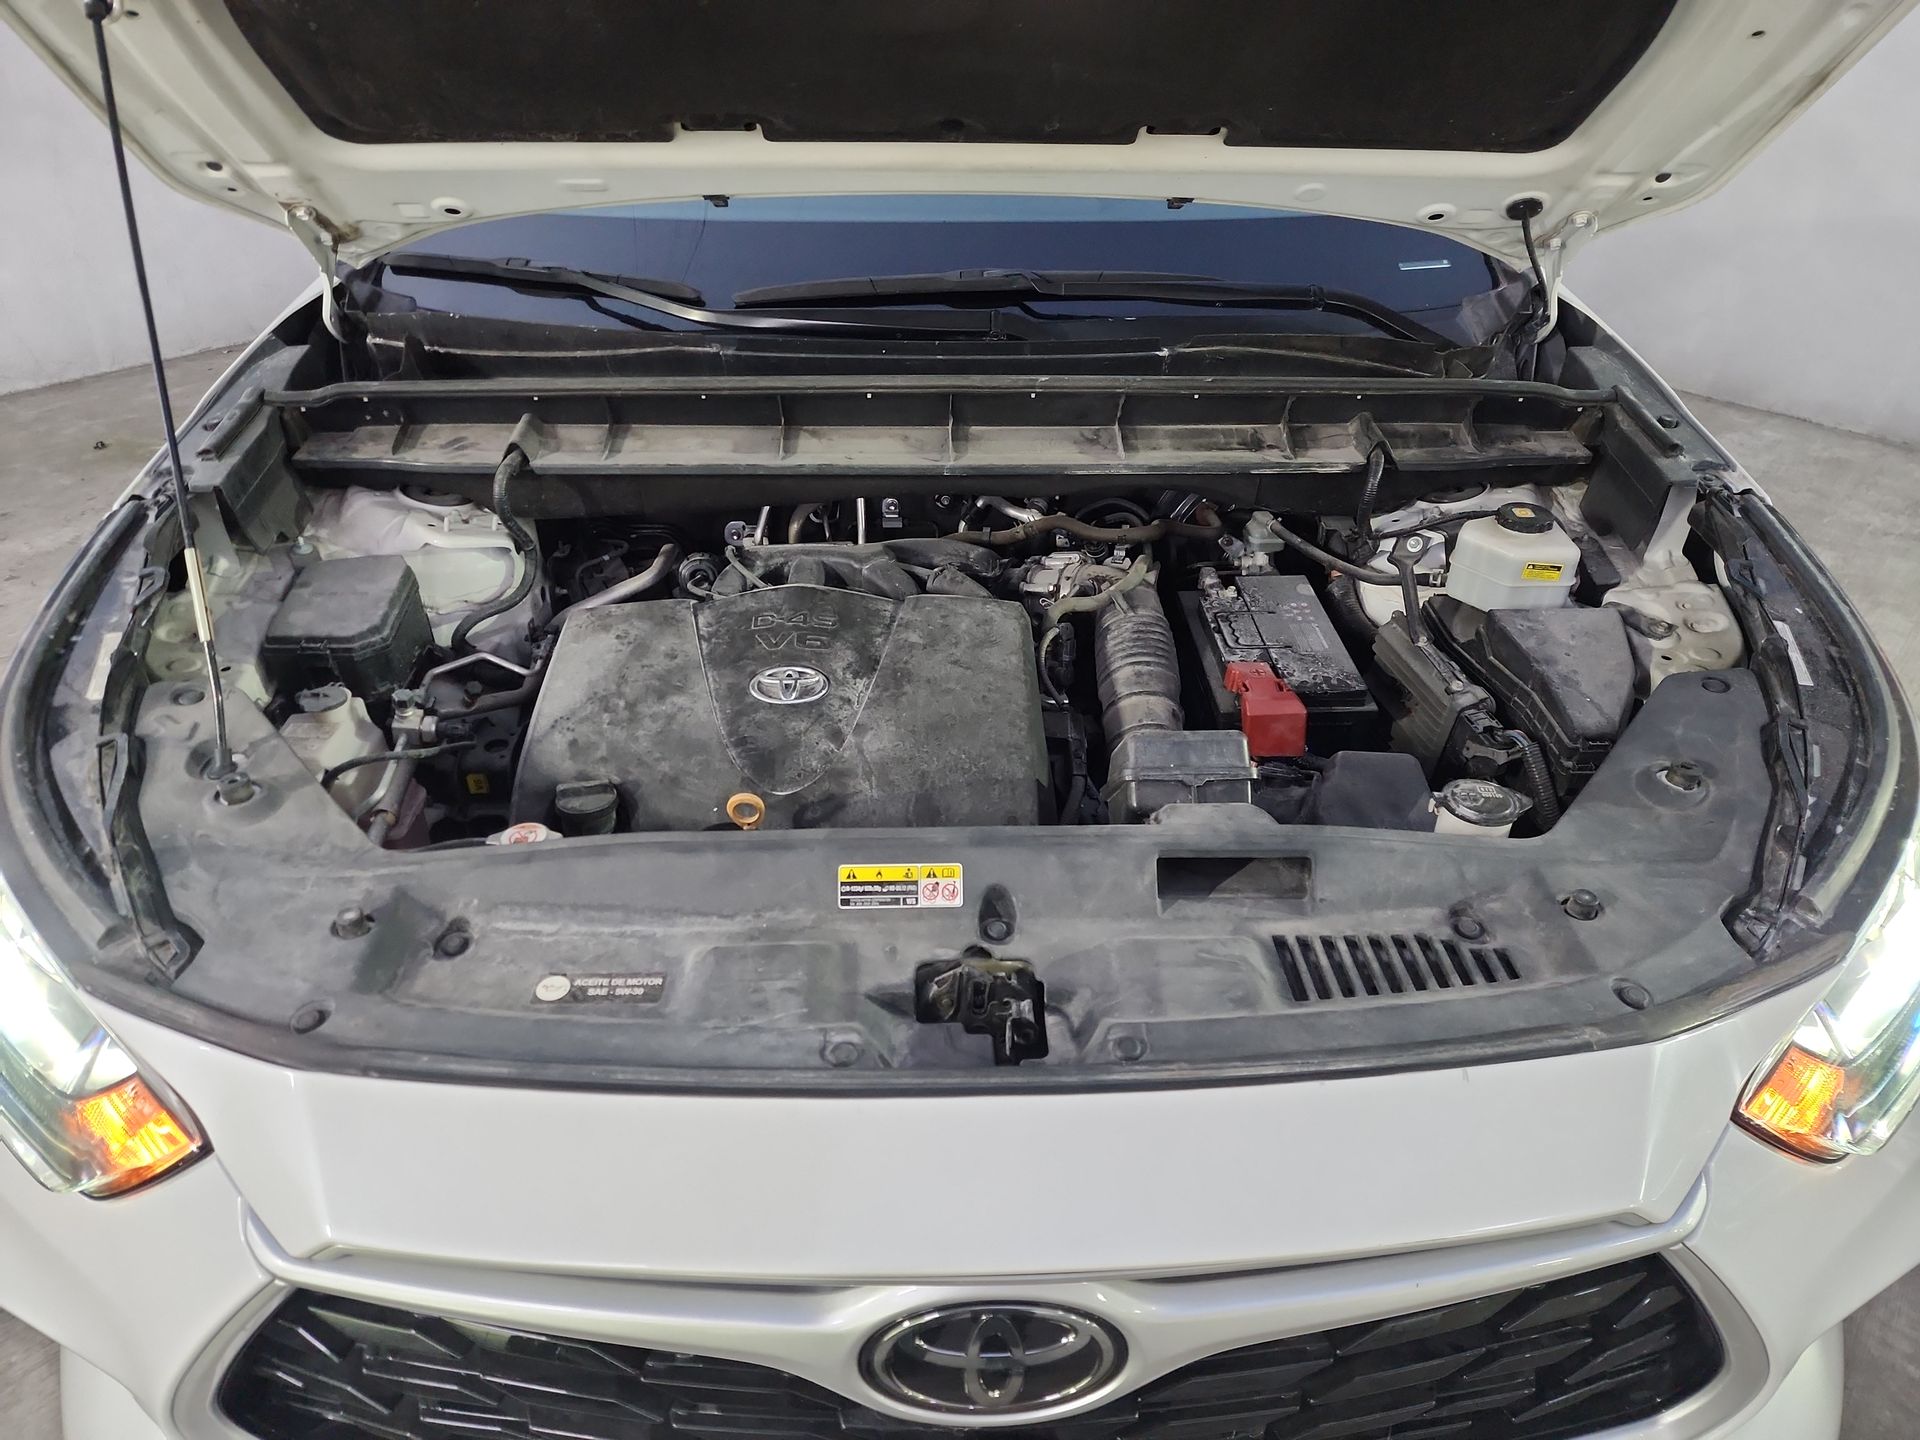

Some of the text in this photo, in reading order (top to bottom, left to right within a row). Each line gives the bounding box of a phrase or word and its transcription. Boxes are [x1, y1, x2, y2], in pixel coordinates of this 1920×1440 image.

[755, 631, 833, 650] V6
[573, 977, 663, 986] ACEITE DE MOTOR
[587, 987, 608, 996] SAE
